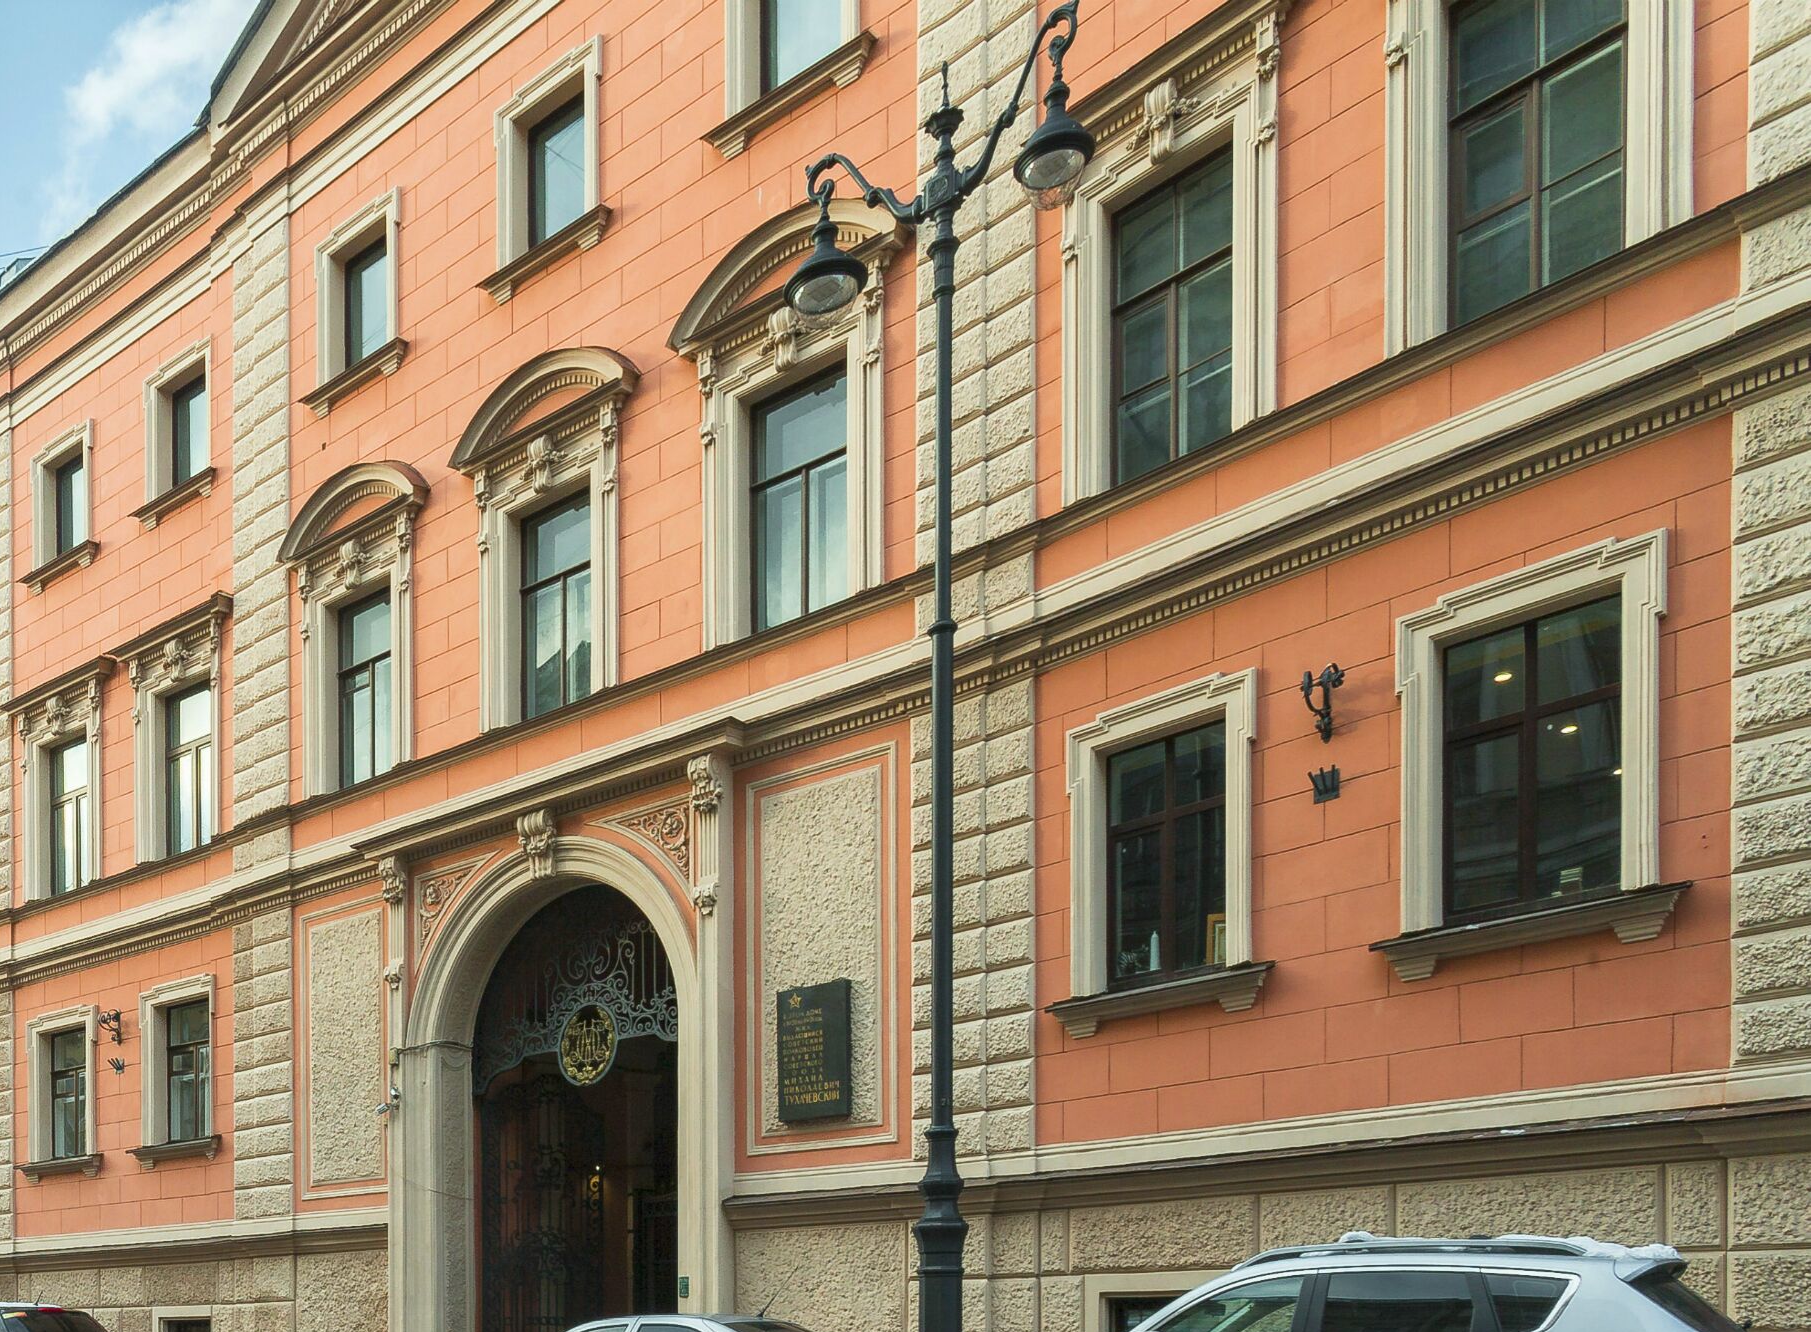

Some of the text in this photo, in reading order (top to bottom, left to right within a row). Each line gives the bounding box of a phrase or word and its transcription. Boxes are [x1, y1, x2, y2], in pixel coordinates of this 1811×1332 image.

[784, 1073, 823, 1085] МИХАИЛ
[783, 1080, 840, 1094] НИКОЛАЕВИЧ
[782, 1090, 840, 1106] ТУХАЧЕВСКИЙ
